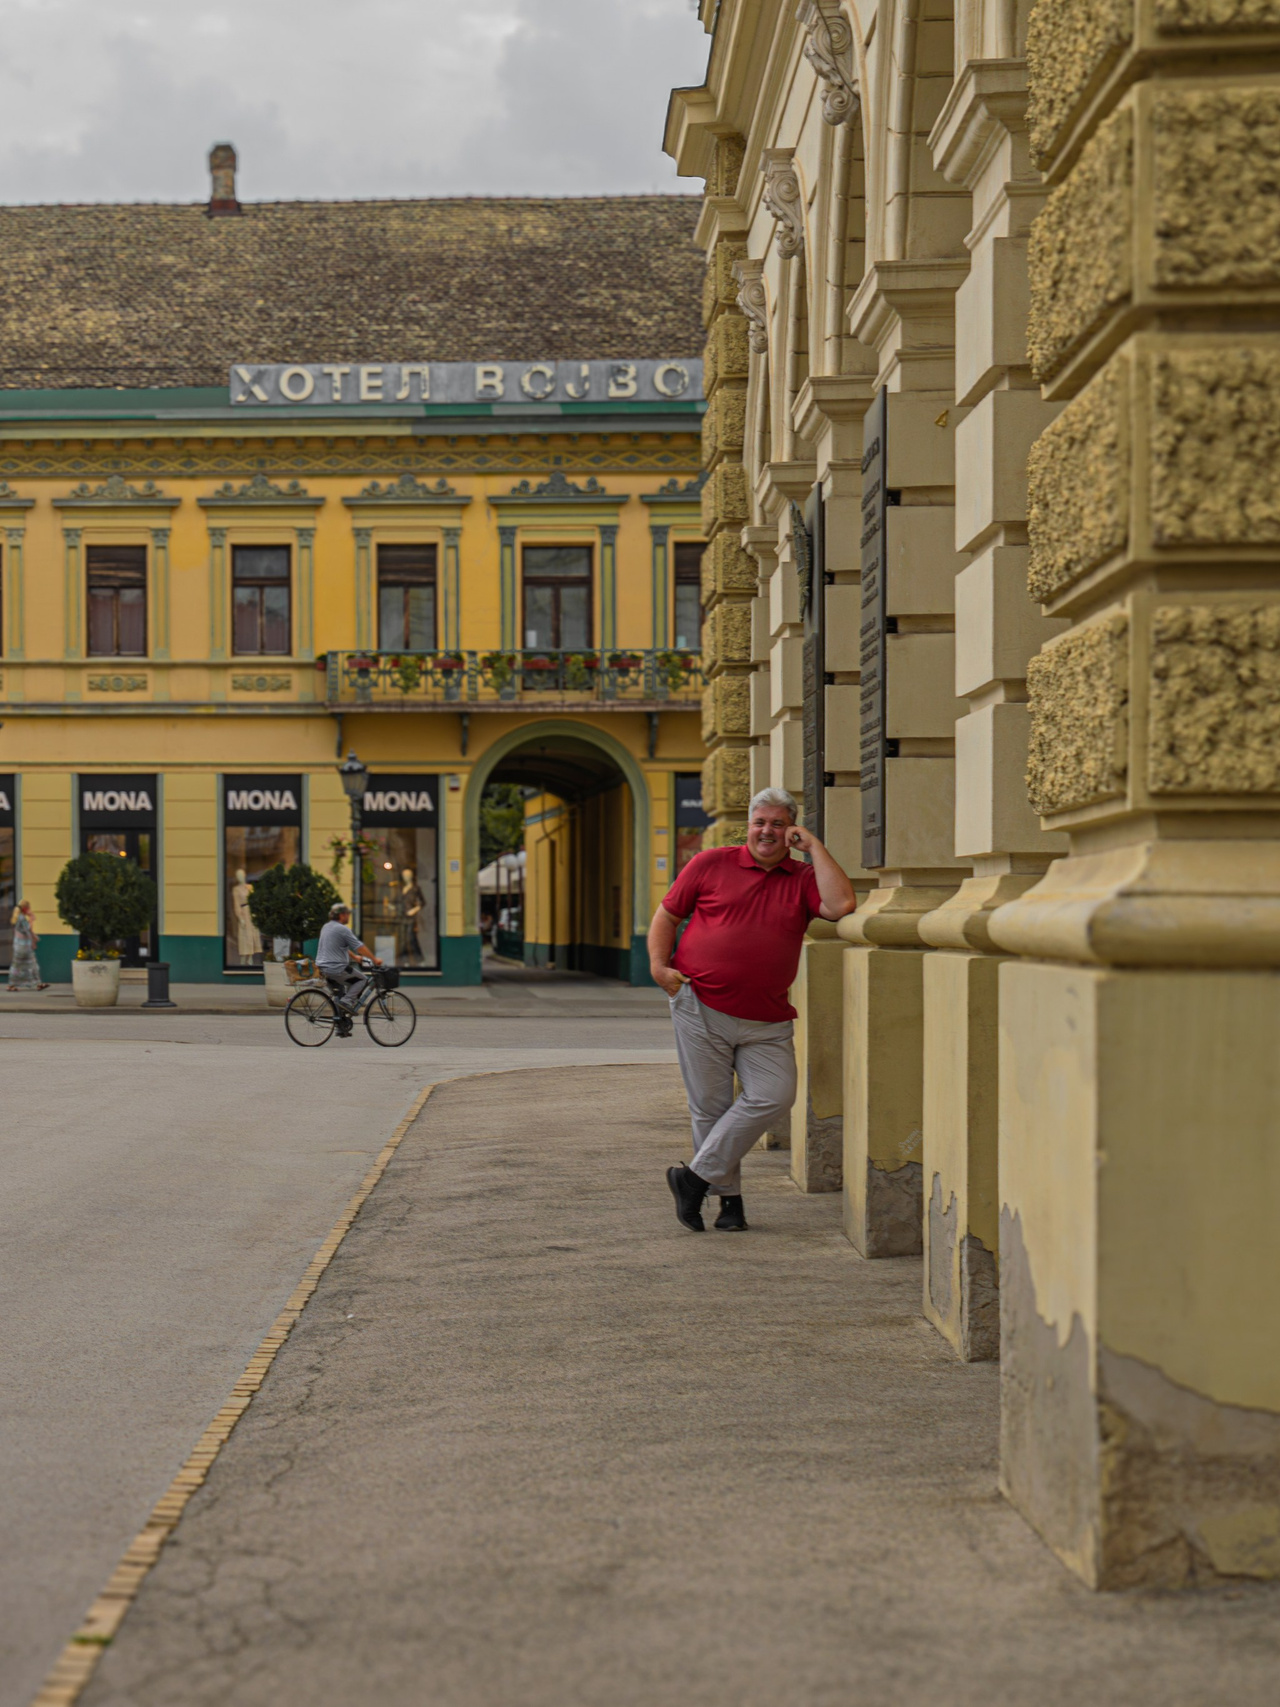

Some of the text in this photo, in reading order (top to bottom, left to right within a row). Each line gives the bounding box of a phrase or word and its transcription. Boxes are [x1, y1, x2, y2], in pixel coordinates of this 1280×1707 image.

[234, 366, 430, 401] ХОТЕЛ
[83, 790, 153, 811] MONA
[227, 789, 298, 810] MONA
[363, 791, 434, 811] MONA
